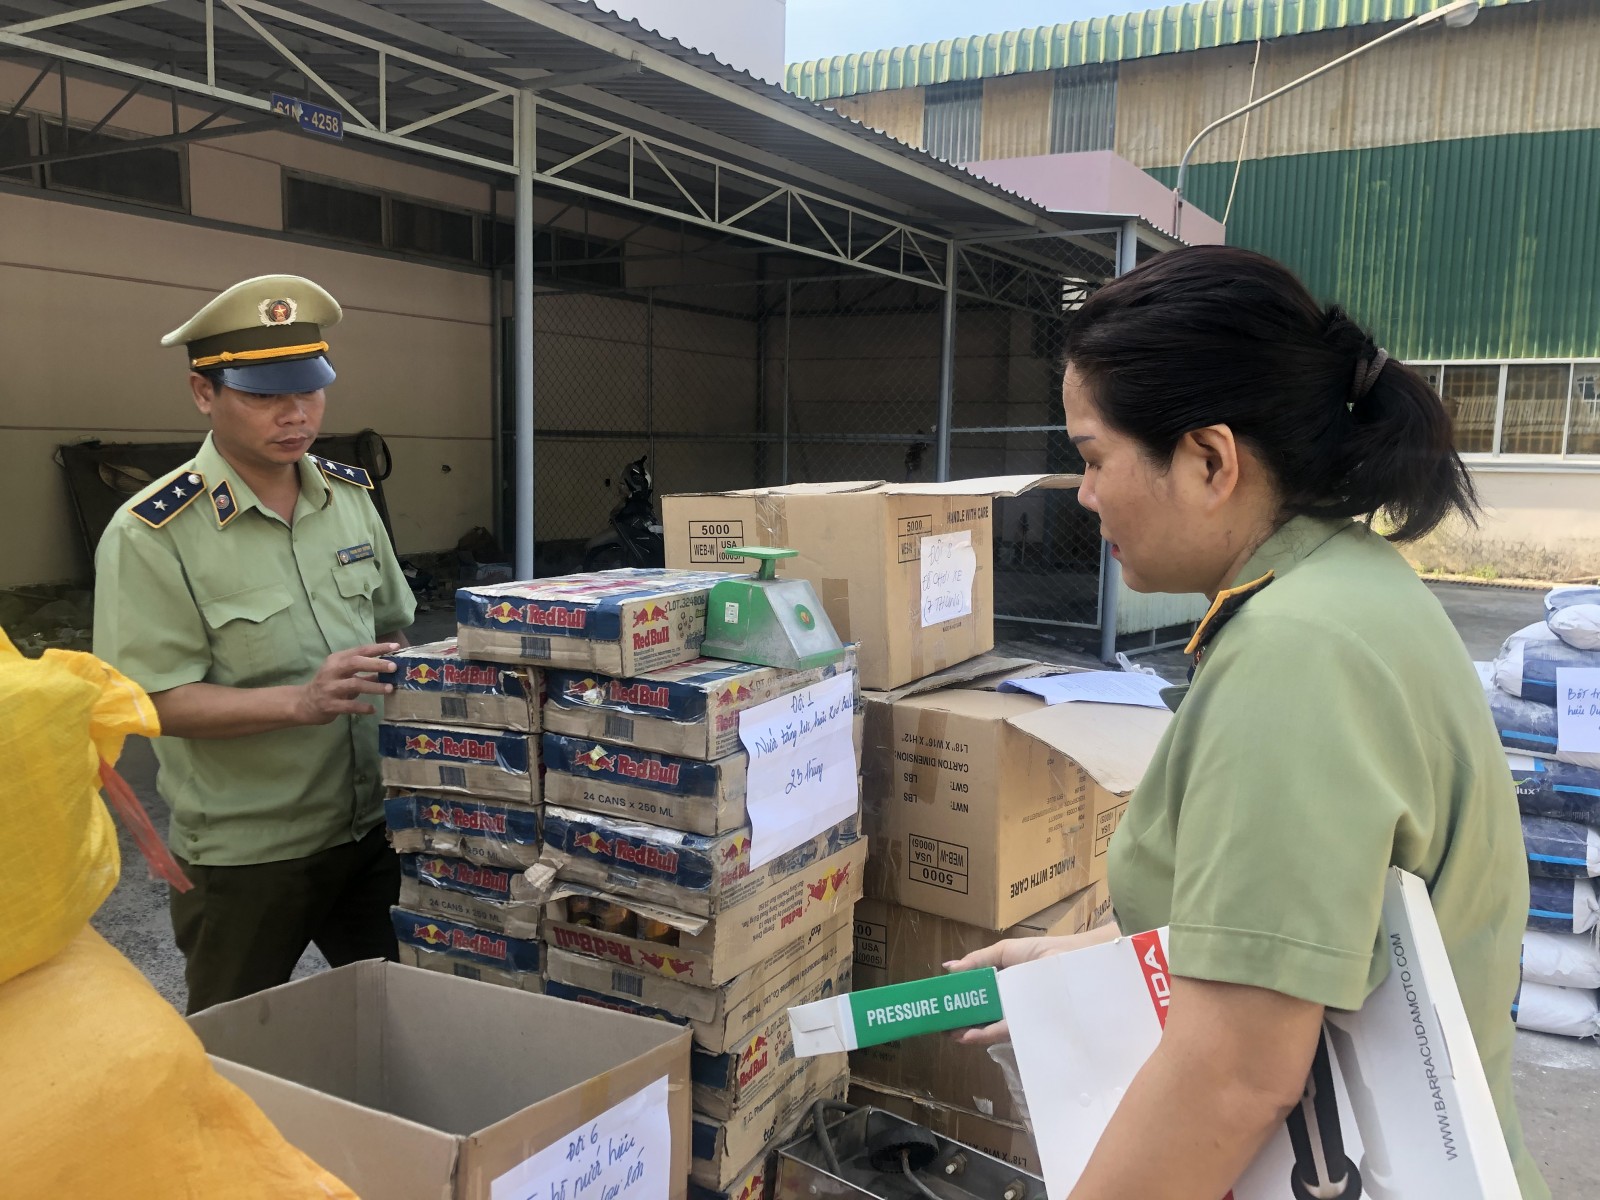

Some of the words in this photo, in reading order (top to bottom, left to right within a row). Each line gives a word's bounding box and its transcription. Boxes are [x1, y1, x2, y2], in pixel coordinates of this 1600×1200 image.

[946, 509, 965, 524] HANDLE
[965, 507, 977, 520] WITH
[977, 506, 989, 519] CARE
[701, 524, 730, 535] 5000
[907, 519, 923, 532] 5000
[693, 544, 715, 556] WEB-W
[720, 541, 737, 549] USA
[918, 736, 924, 745] X
[945, 741, 951, 749] X
[894, 750, 936, 767] DIMENSION:
[937, 759, 969, 773] CARTON
[903, 772, 918, 783] LBS
[949, 781, 969, 793] GWT:
[583, 791, 595, 801] 24
[598, 794, 626, 807] CANS
[638, 802, 656, 813] 250
[660, 806, 674, 818] ML
[903, 792, 918, 803] LBS
[950, 801, 969, 813] NWT:
[1101, 824, 1111, 835] USA
[912, 840, 936, 852] (0005)
[914, 851, 932, 863] USA
[940, 849, 964, 867] WEB-W
[1049, 855, 1076, 879] HANDLE
[922, 867, 954, 886] 5000
[1030, 868, 1048, 889] WITH
[1010, 875, 1029, 898] CARE
[429, 898, 439, 907] 24
[441, 900, 464, 913] CANS
[861, 943, 880, 953] USA
[866, 997, 940, 1027] PRESSURE
[944, 988, 989, 1012] GAUGE
[1390, 933, 1458, 1161] WWW.BARRACUDAMOTO.COM
[590, 1123, 598, 1144] 6
